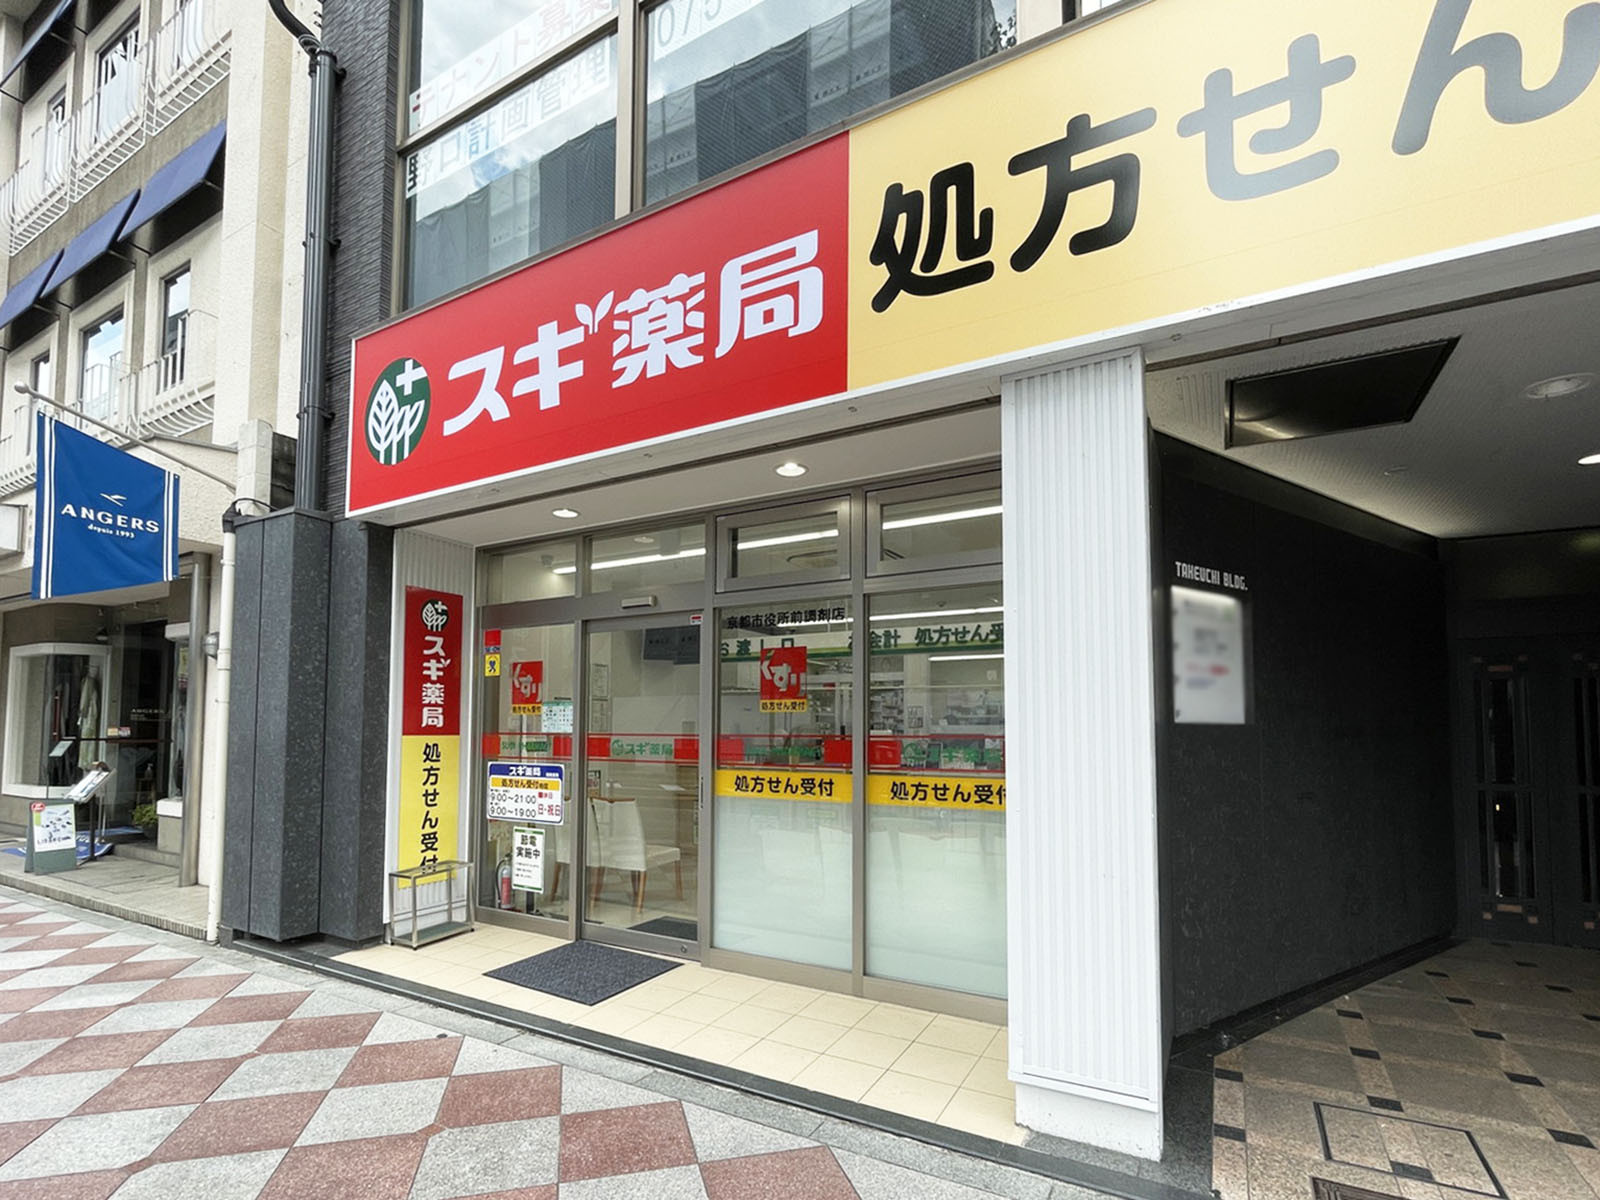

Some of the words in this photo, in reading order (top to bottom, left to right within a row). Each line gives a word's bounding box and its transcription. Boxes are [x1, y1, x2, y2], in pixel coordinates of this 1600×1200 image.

[869, 0, 1600, 314] 処方せん
[442, 229, 824, 437] スギ薬局
[61, 503, 161, 533] ANGERS
[115, 530, 136, 539] 1993
[1175, 561, 1221, 585] TAKEUCHI
[1223, 572, 1248, 590] BLDG.
[727, 607, 846, 629] 京都市役所前調剤店
[420, 634, 451, 728] スギ薬局
[501, 777, 549, 789] 処方せん受付
[734, 775, 835, 797] 処方せん受付
[420, 742, 442, 875] 処方せん受付
[516, 846, 541, 859] 実施中
